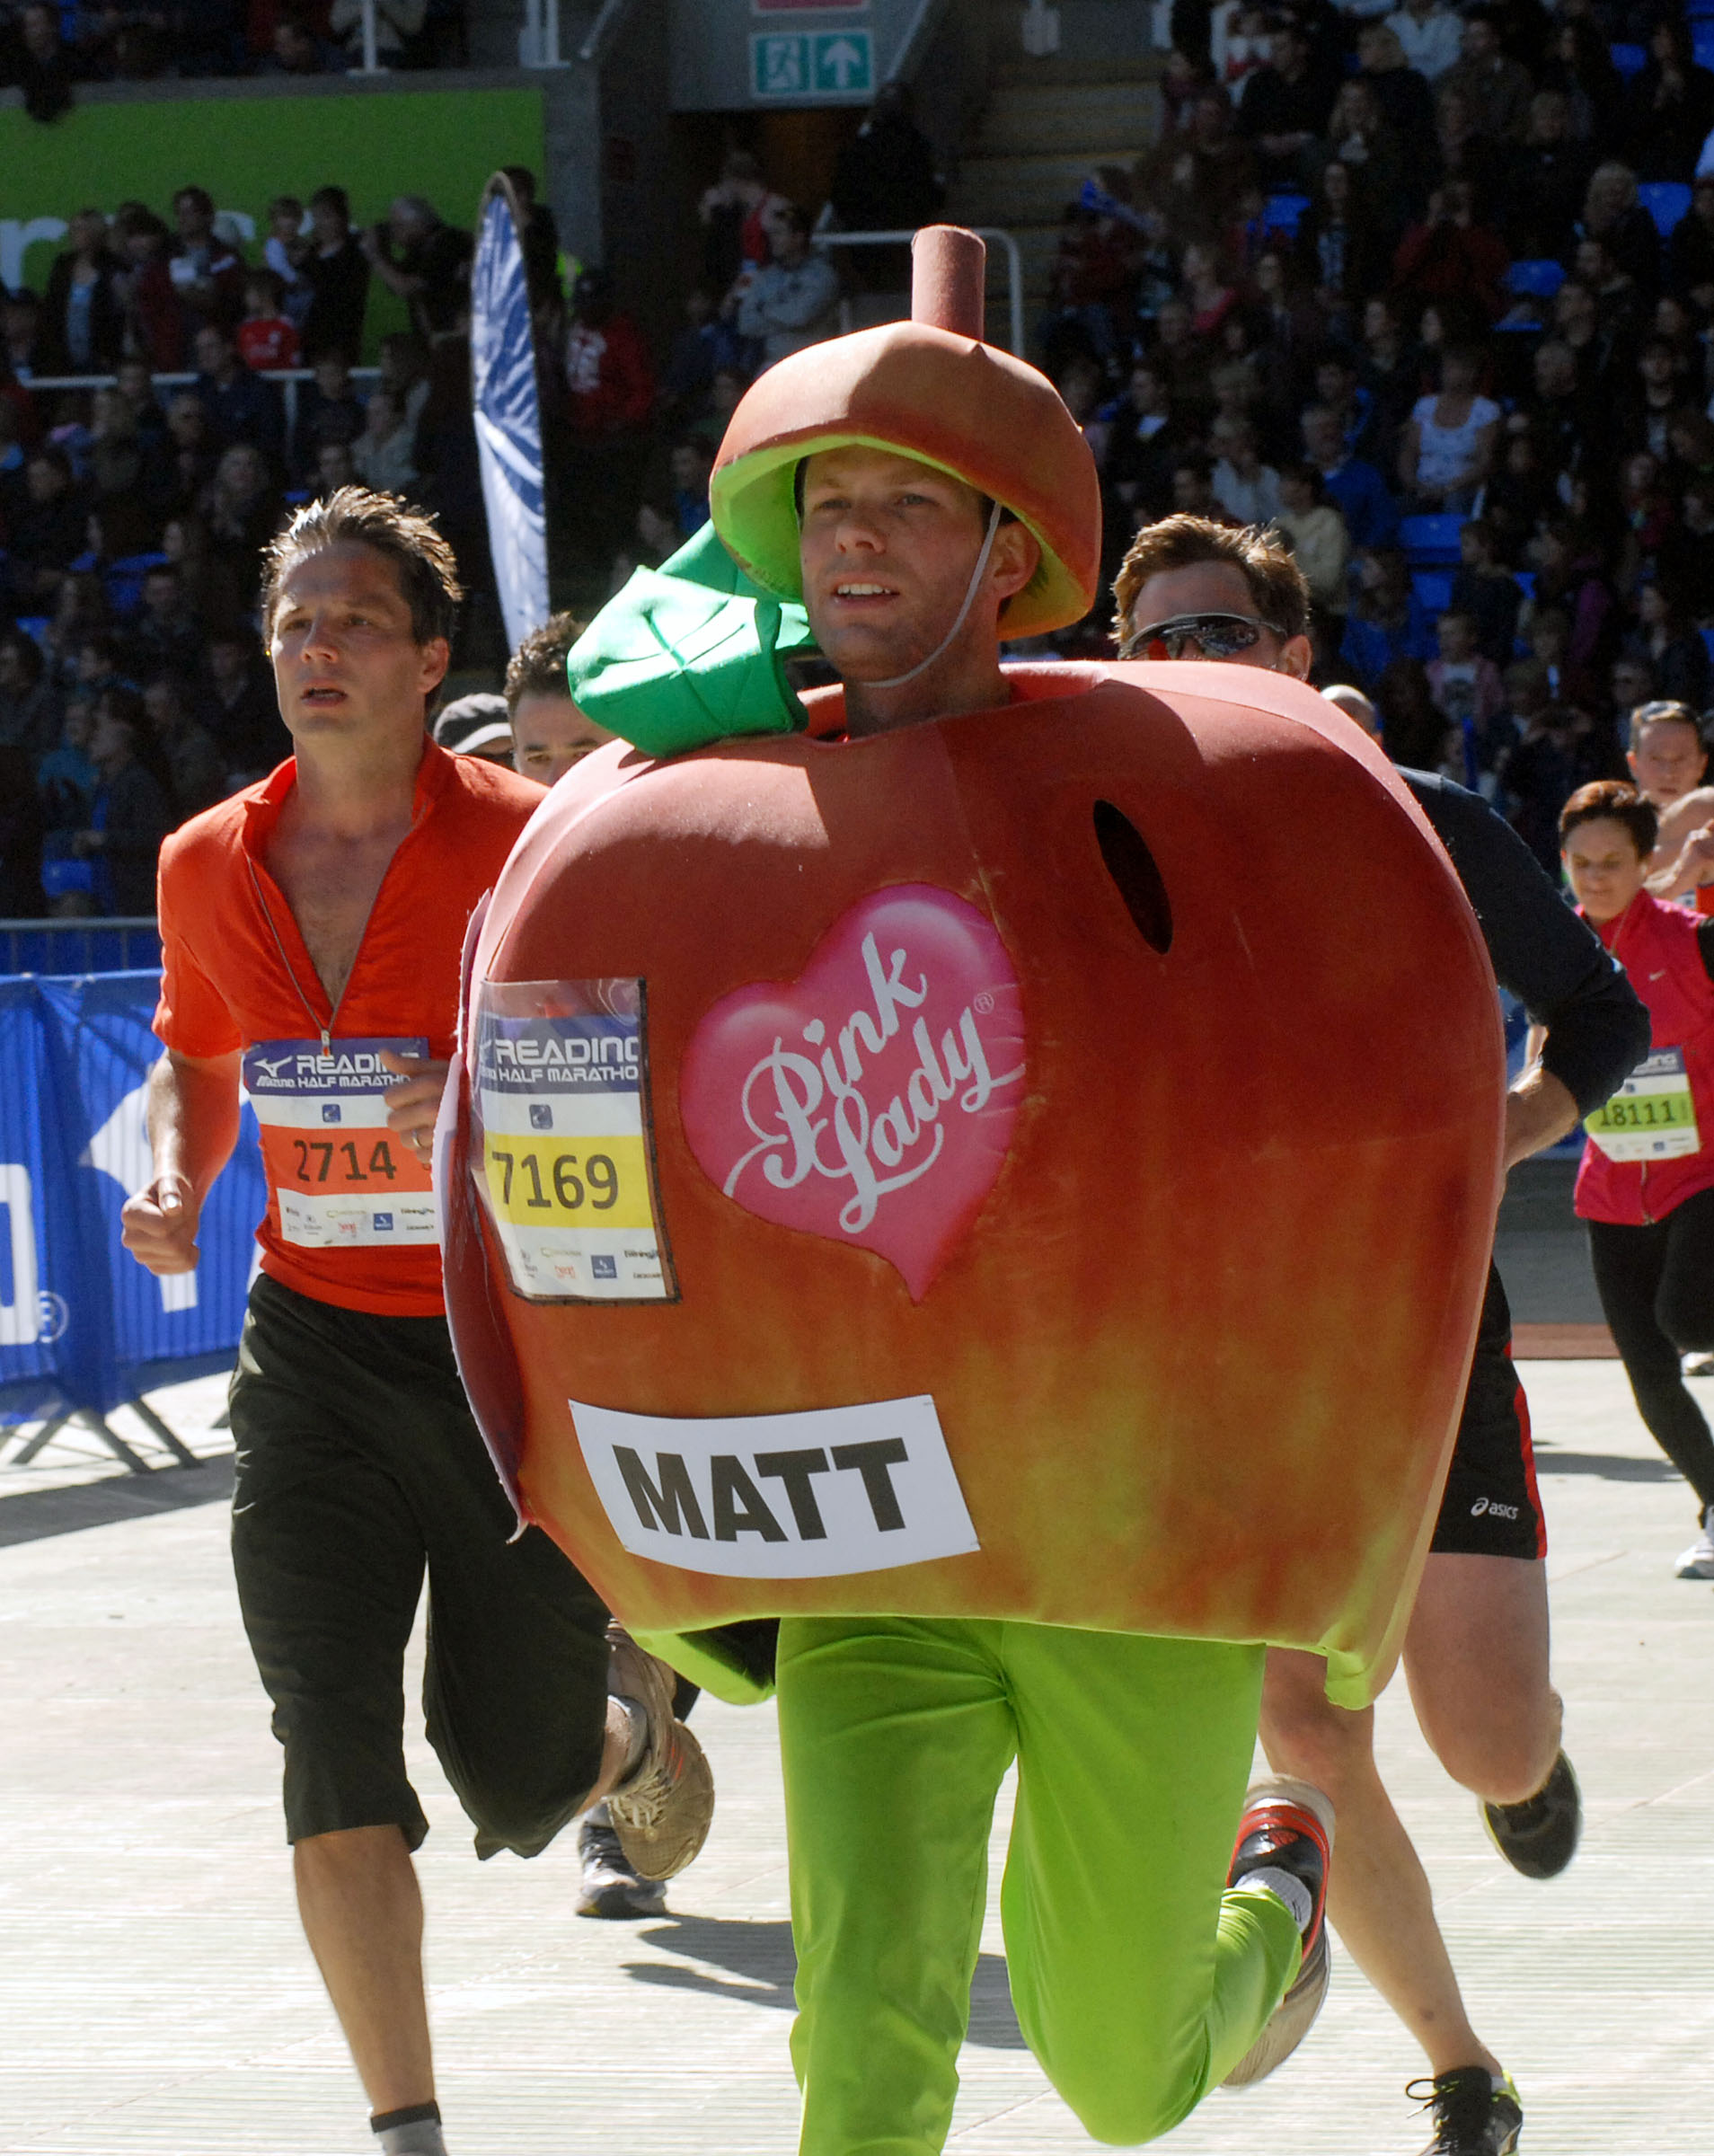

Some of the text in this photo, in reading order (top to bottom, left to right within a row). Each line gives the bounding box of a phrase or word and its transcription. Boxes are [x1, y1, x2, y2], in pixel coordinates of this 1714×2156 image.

[296, 1053, 420, 1074] READI
[297, 1074, 411, 1088] HALF MARATHO
[498, 1067, 543, 1082] HALF
[547, 1065, 639, 1082] MARATHO
[722, 931, 927, 1197] Pink
[814, 1005, 1026, 1234] Lady
[1600, 1100, 1675, 1127] 18111
[294, 1139, 397, 1182] 2714
[491, 1151, 619, 1210] 7169
[612, 1437, 908, 1542] MATT
[1489, 1502, 1519, 1520] asics
